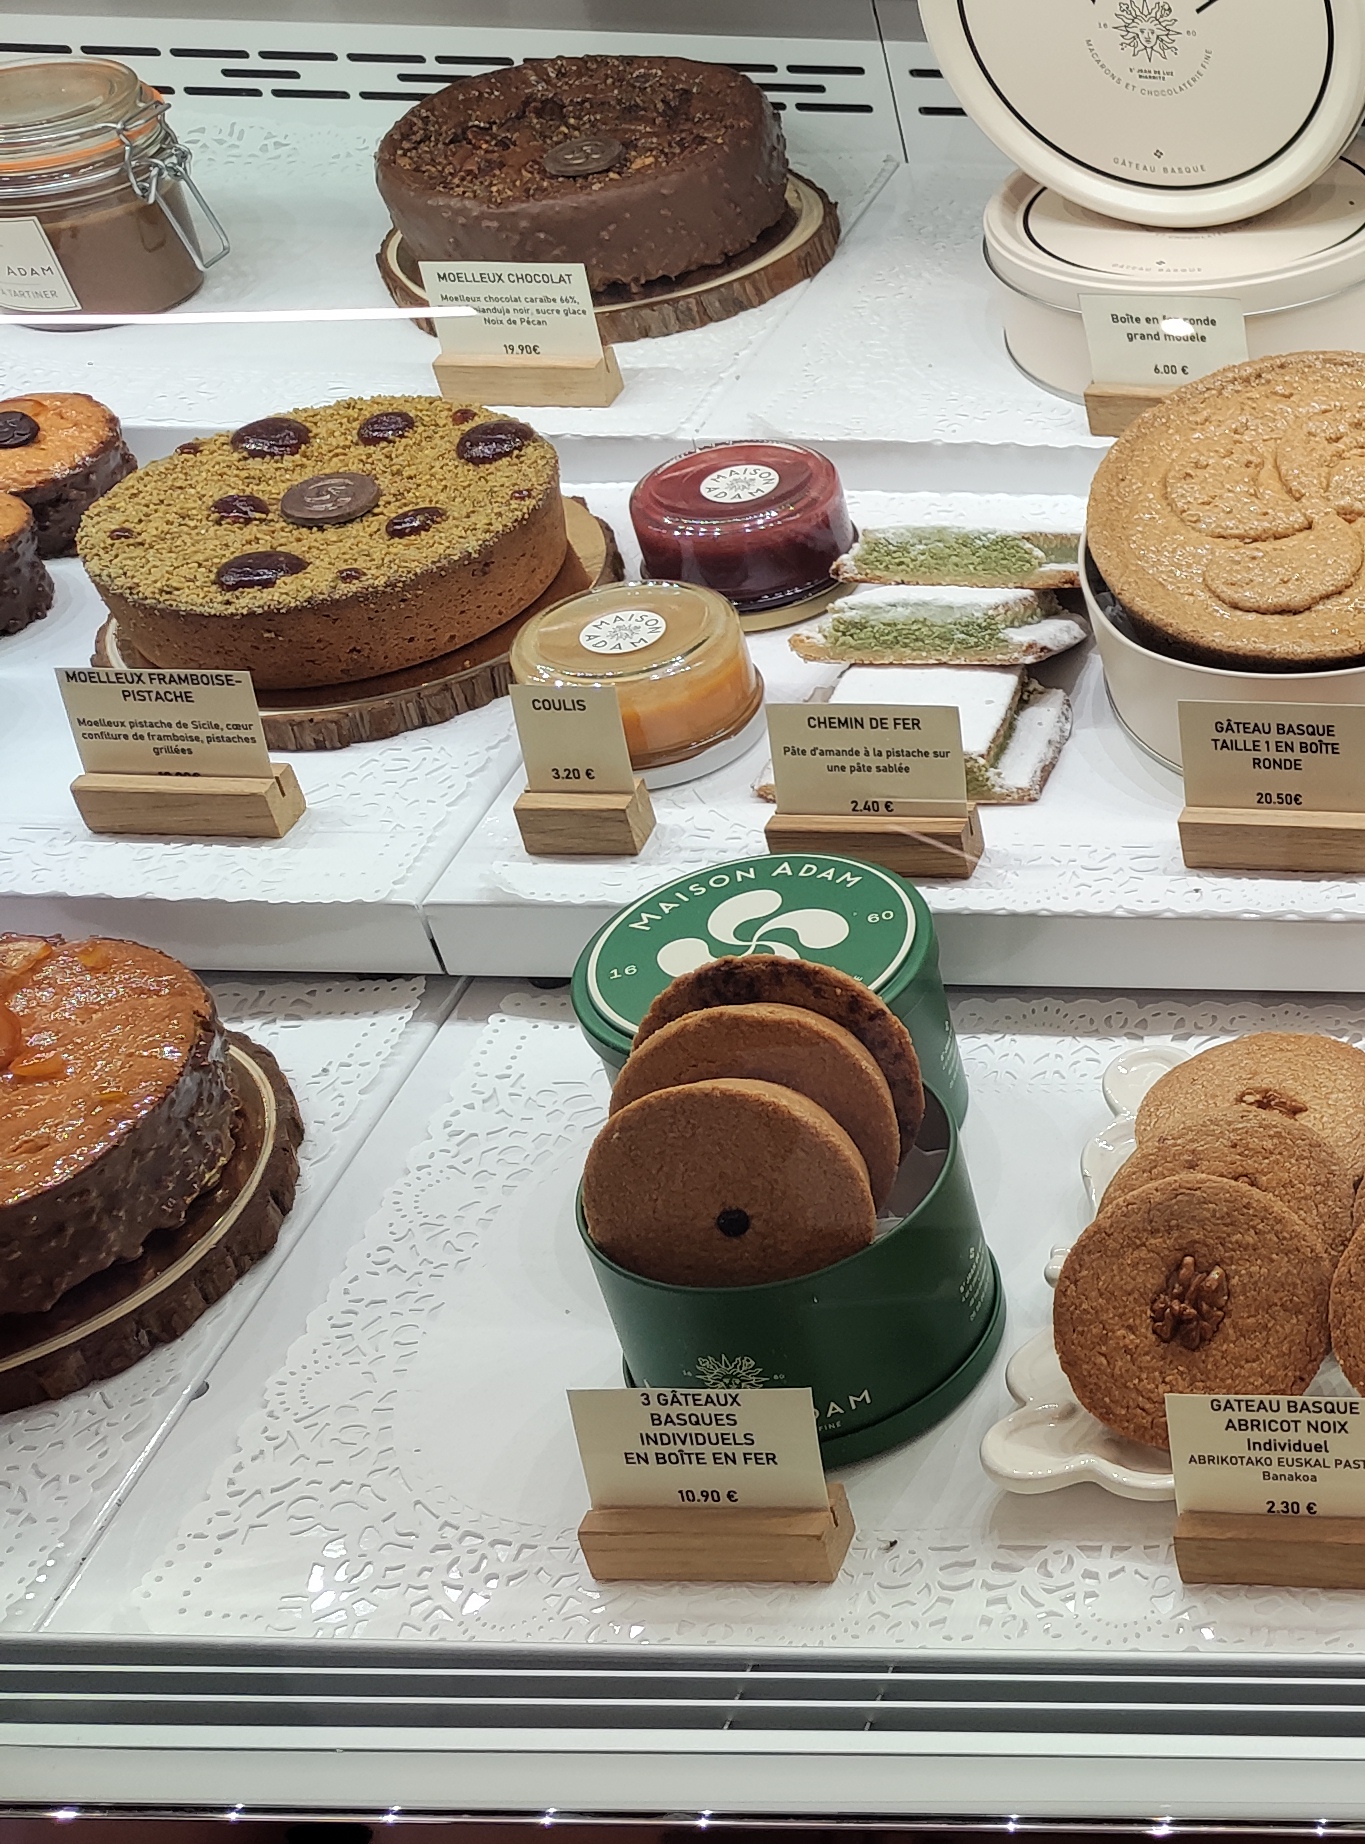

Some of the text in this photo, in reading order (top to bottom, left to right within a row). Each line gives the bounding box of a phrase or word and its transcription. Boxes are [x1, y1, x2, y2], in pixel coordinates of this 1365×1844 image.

[1086, 39, 1212, 96] MACARONS ET CHOCOLATERIE FINE
[1114, 158, 1206, 174] GÂTEAU BASQUE
[7, 266, 54, 276] ADAM
[437, 272, 572, 284] MOELLEUX CHOCOLAT
[441, 294, 481, 302] Moelleux
[484, 295, 521, 303] chocolat
[520, 317, 547, 326] Pécan
[1127, 332, 1160, 342] grand
[503, 345, 541, 355] 19.90€
[711, 468, 776, 485] MAISON
[706, 487, 764, 500] ADAM
[593, 613, 662, 634] MAISON
[584, 634, 647, 651] ADAM
[66, 671, 242, 686] MOELLEUX FRAMBOISE-
[122, 690, 195, 703] PISTACHE
[532, 699, 586, 711] COULIS
[77, 718, 126, 727] Moelleux
[129, 720, 172, 729] pistache
[176, 721, 188, 729] de
[191, 721, 224, 731] Sicile,
[808, 717, 921, 730] CHEMIN DE FER
[1215, 719, 1335, 737] GÂTEAU BASQUE
[82, 732, 256, 744] confiture de framboise, pistaches
[153, 746, 193, 755] grillées
[784, 746, 950, 759] Pâte d'amande à la pistache sur
[1211, 739, 1340, 755] TAILLE 1 EN BOÎTE
[827, 763, 910, 774] une pâte sablée
[1253, 758, 1302, 770] RONDE
[552, 768, 595, 780] 3.20 €
[1257, 793, 1303, 805] 20.50€
[851, 801, 894, 812] 2.40 €
[628, 862, 863, 932] MAISON ADAM
[867, 911, 894, 923] 60
[609, 965, 637, 979] 16
[640, 1390, 741, 1407] 3 GÂTEAUX
[1210, 1399, 1360, 1415] GATEAU BASQUE
[650, 1413, 738, 1426] BASQUES
[1225, 1419, 1349, 1433] ABRICOT NOIX
[640, 1432, 755, 1446] INDIVIDUELS
[1247, 1439, 1329, 1453] Individuel
[624, 1449, 778, 1466] EN BOÎTE EN FER
[1188, 1455, 1273, 1467] ABRIKOTAKO
[1278, 1457, 1330, 1468] EUSKAL
[678, 1489, 738, 1502] 10.90 €
